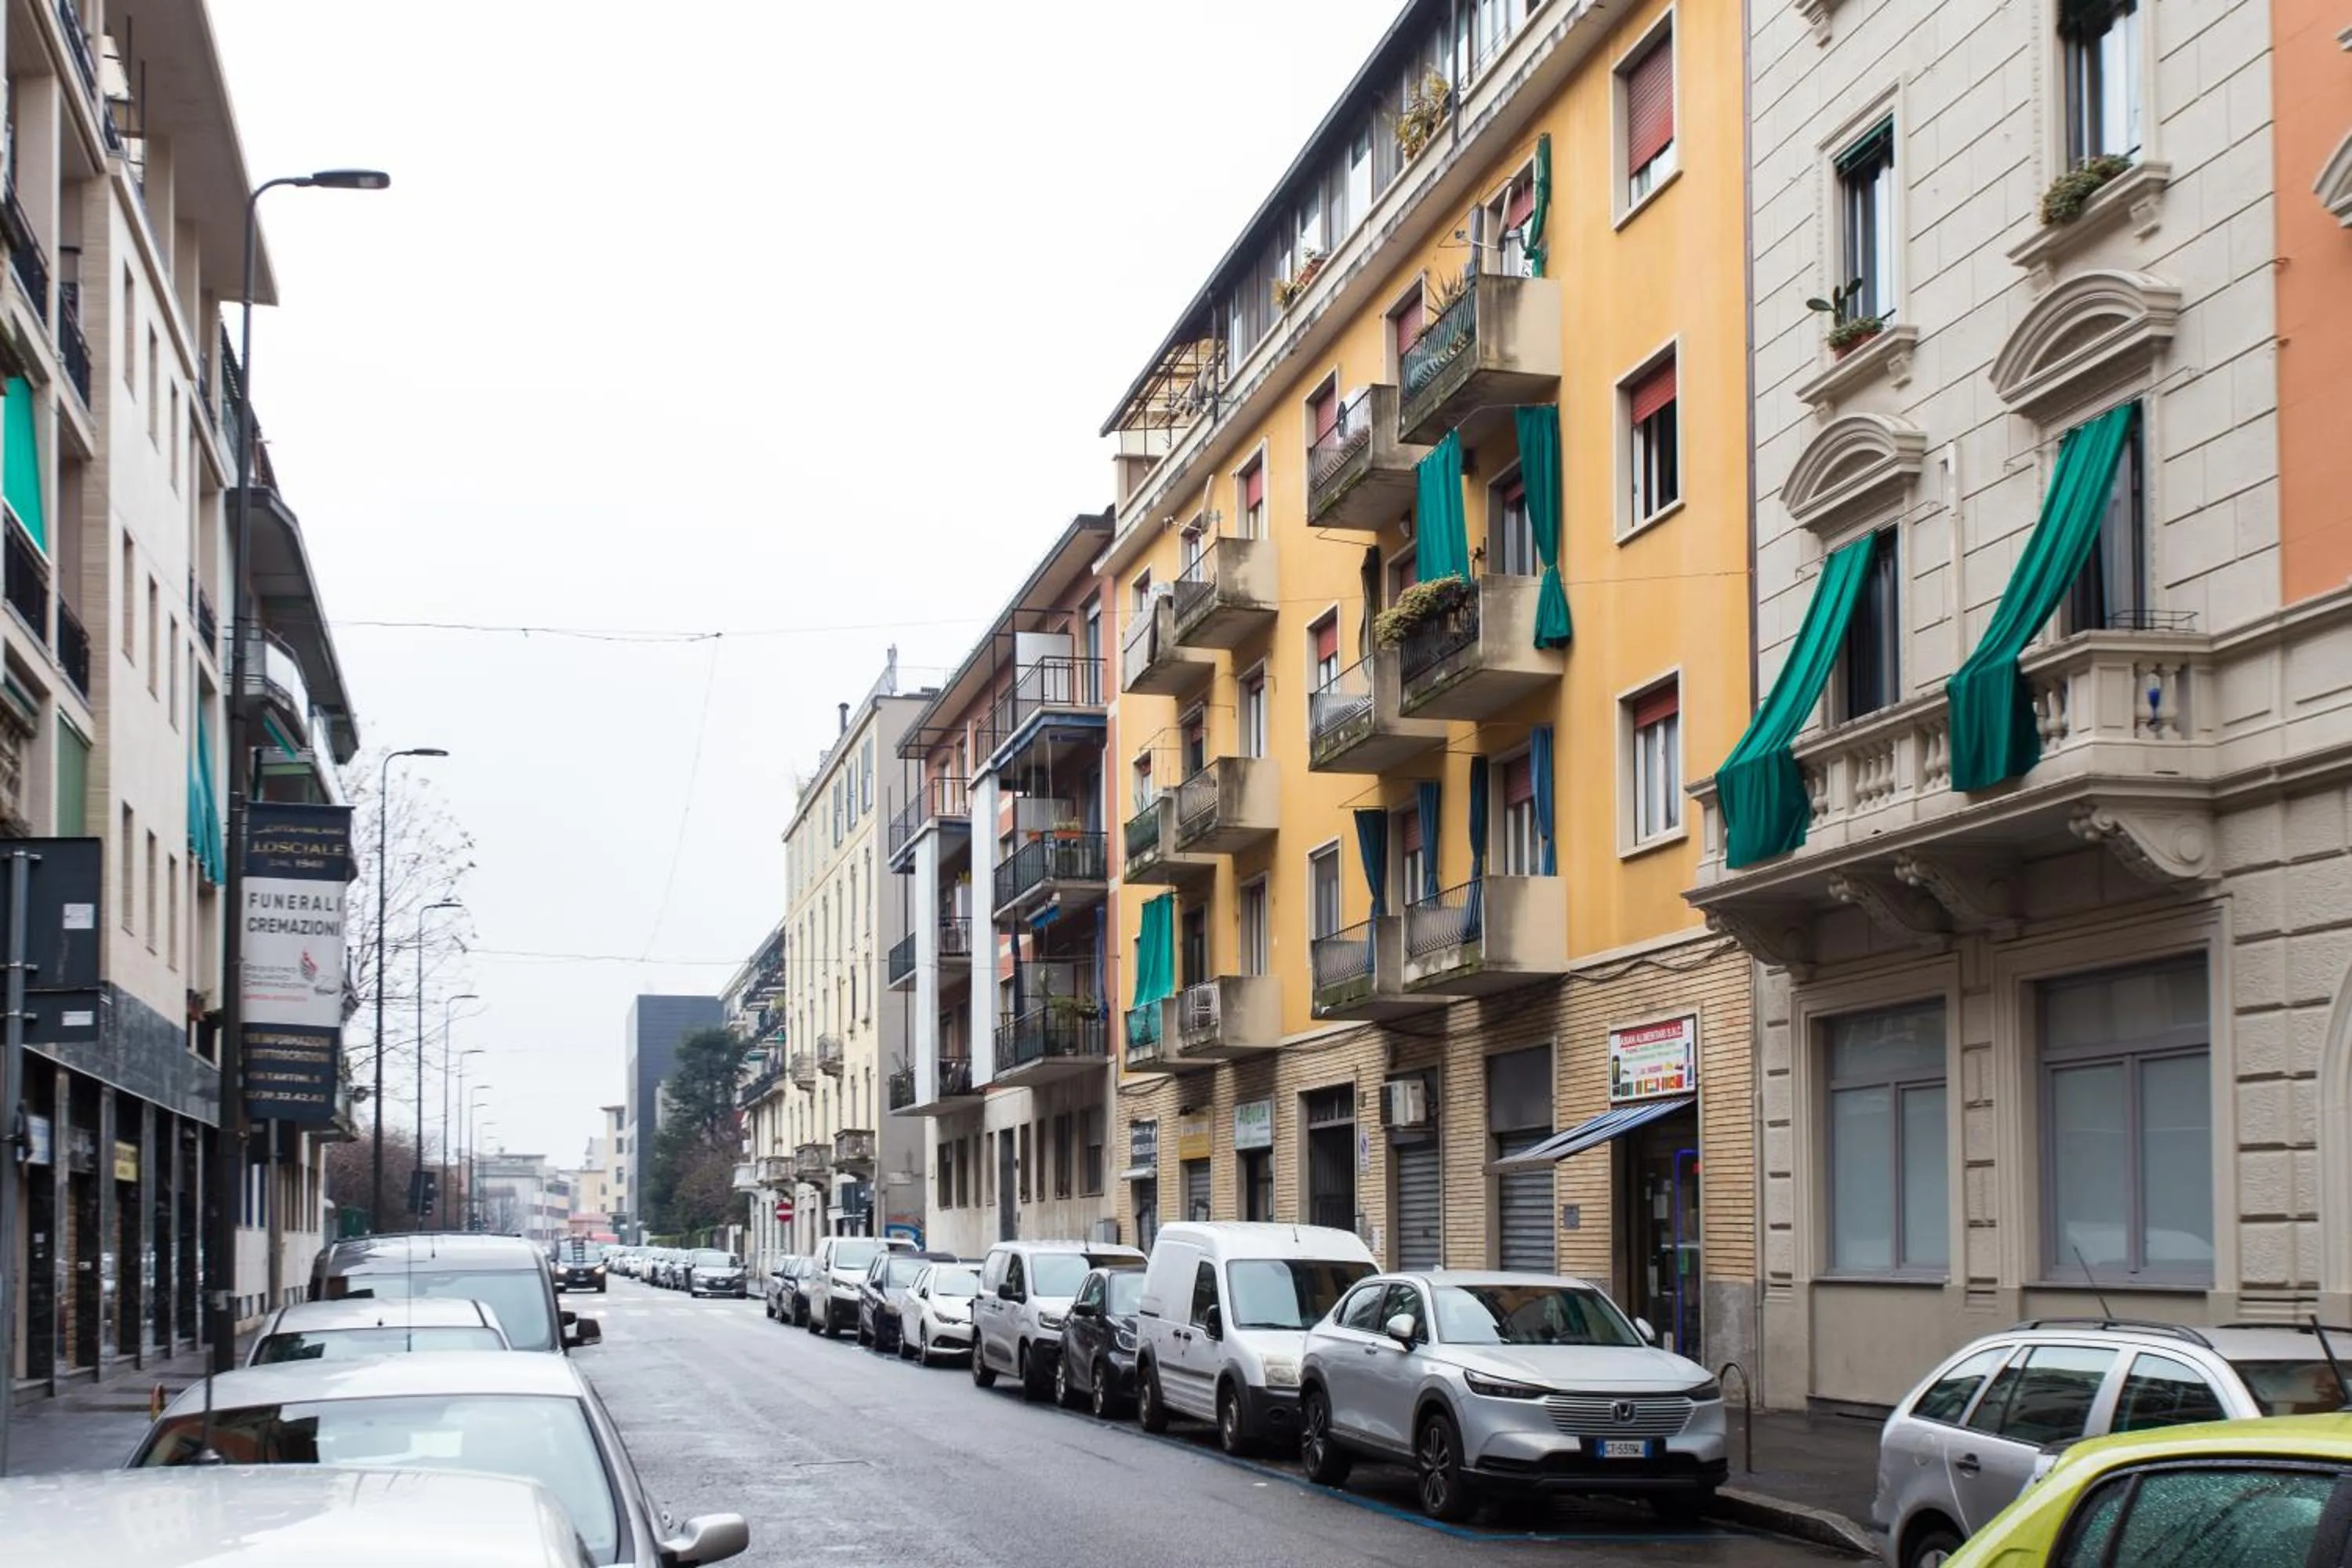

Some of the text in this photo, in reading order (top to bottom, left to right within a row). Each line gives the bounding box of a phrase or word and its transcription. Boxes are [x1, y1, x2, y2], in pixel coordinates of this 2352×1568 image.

[251, 840, 346, 856] LOSCIALE
[248, 892, 343, 913] FUNERALI
[247, 916, 342, 937] CREMAZIONI
